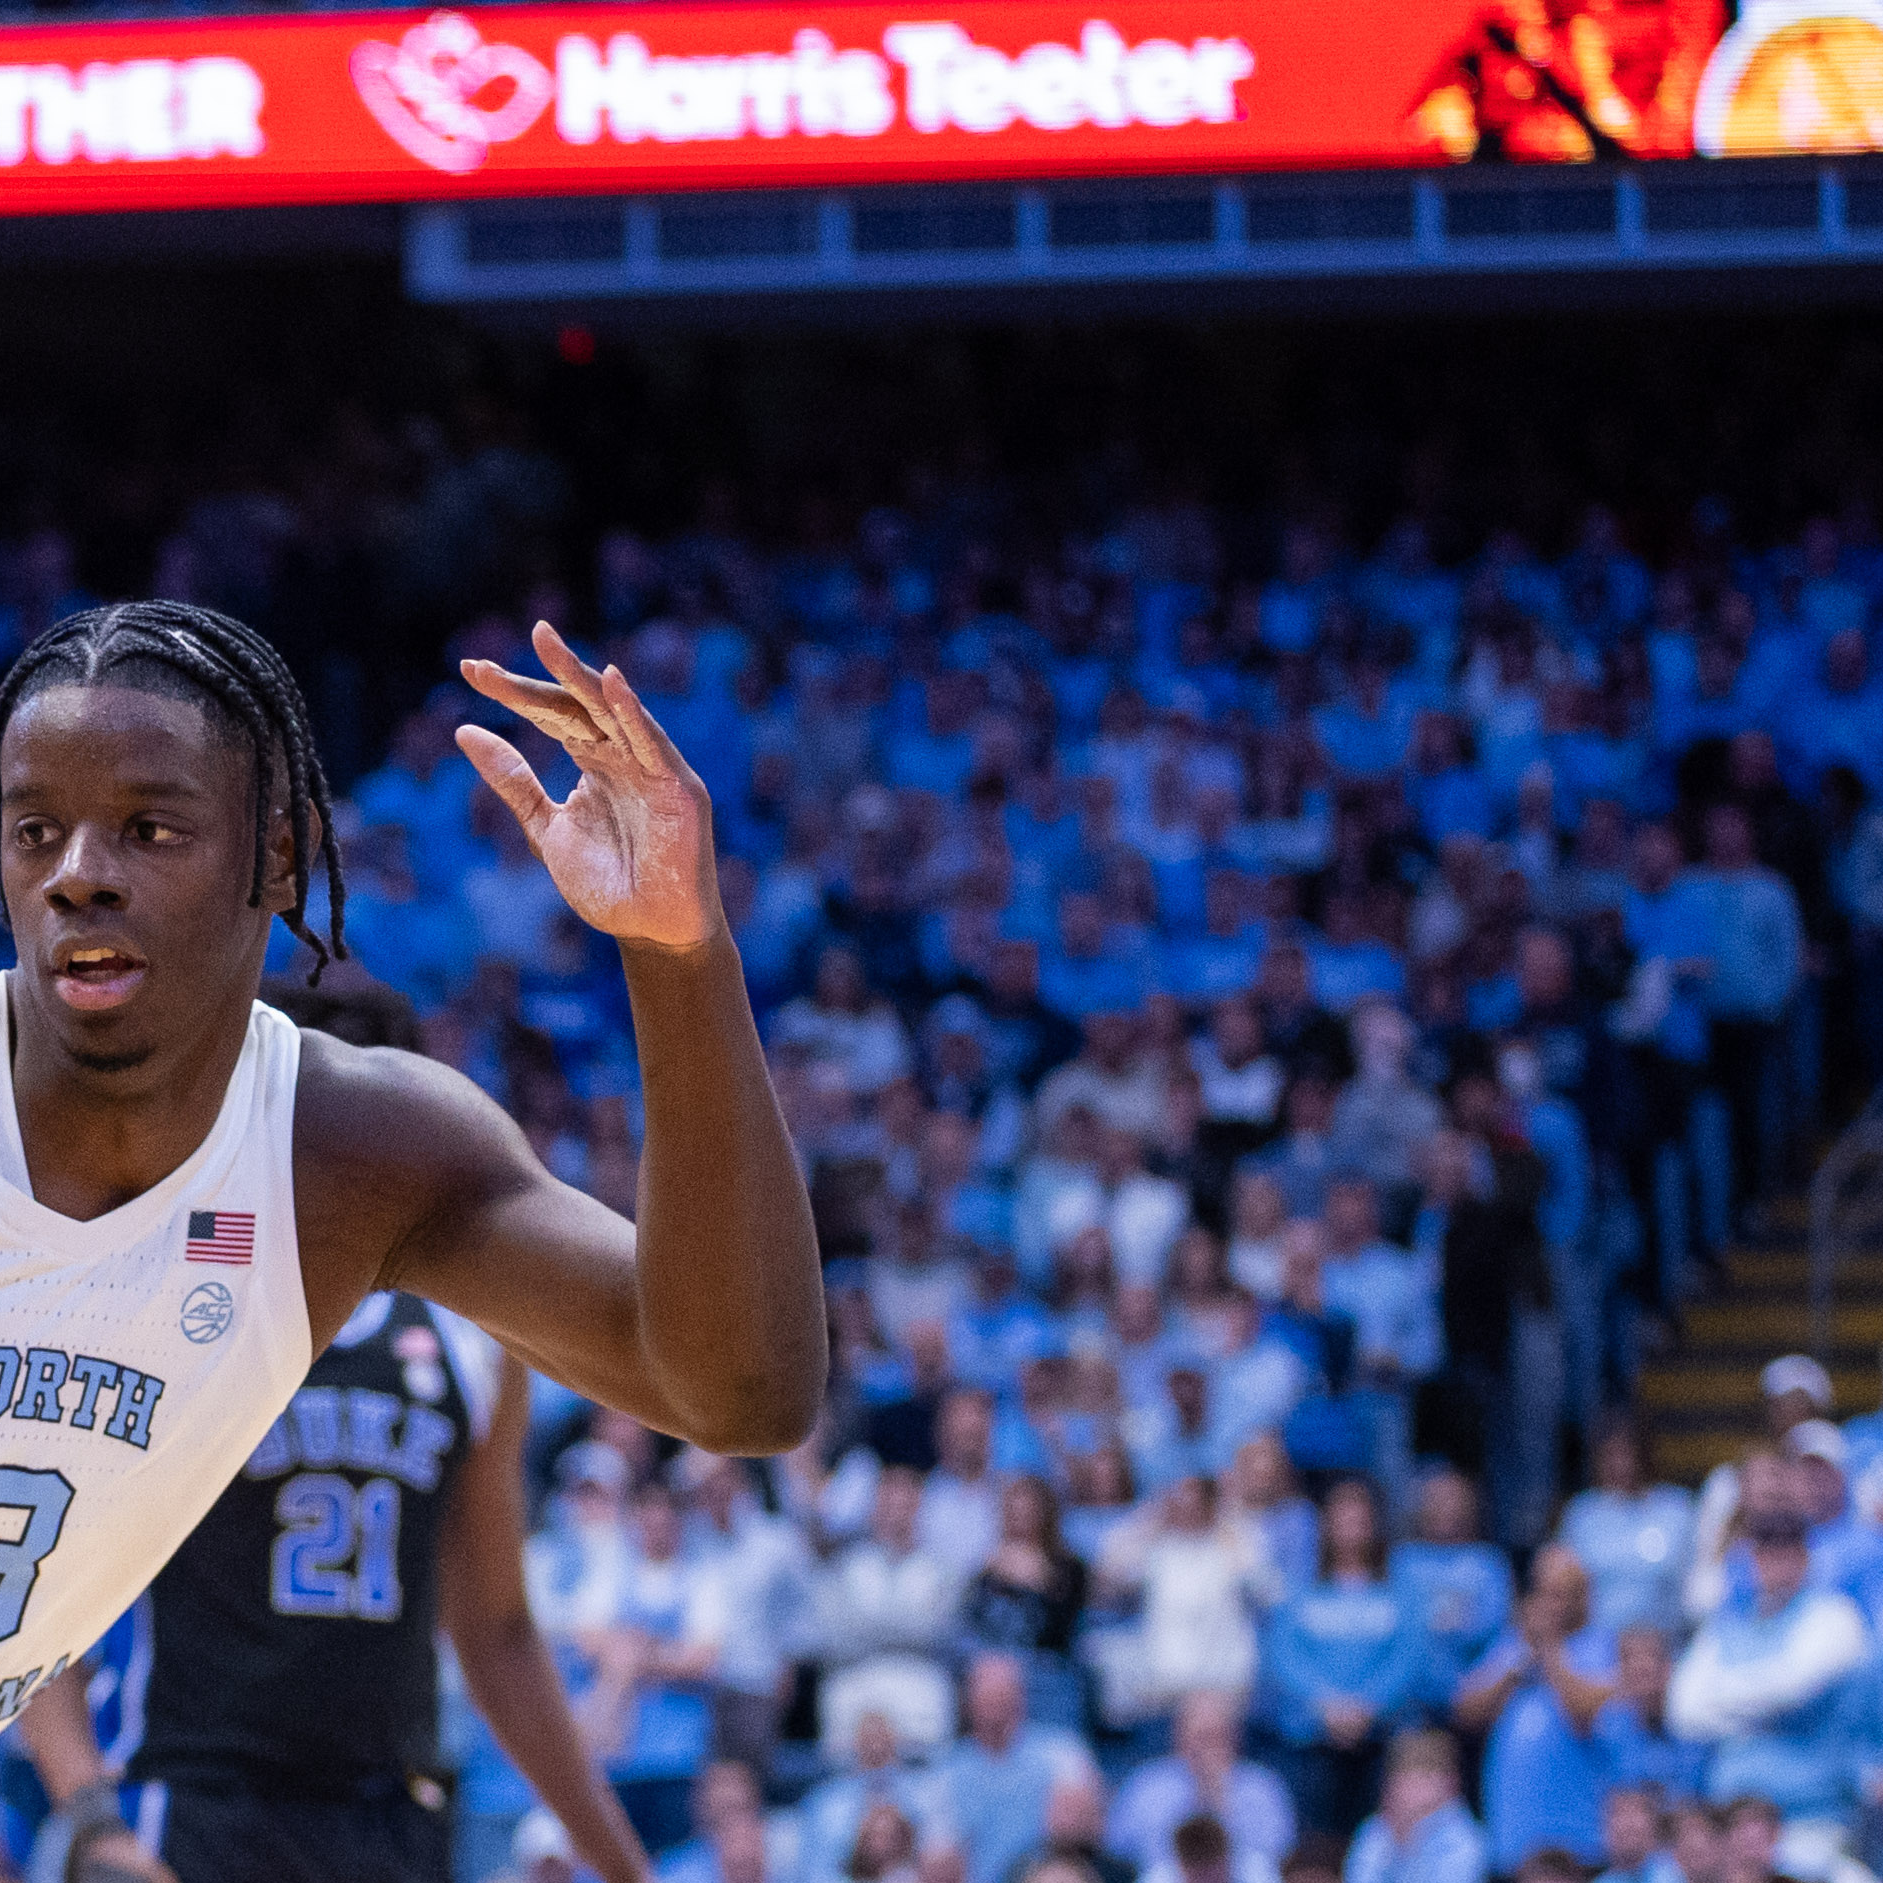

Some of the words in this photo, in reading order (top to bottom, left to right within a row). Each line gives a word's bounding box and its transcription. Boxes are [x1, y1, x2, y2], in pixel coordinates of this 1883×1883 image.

[555, 28, 896, 144] Harris
[882, 20, 1256, 134] Teeter
[269, 1471, 402, 1622] 21
